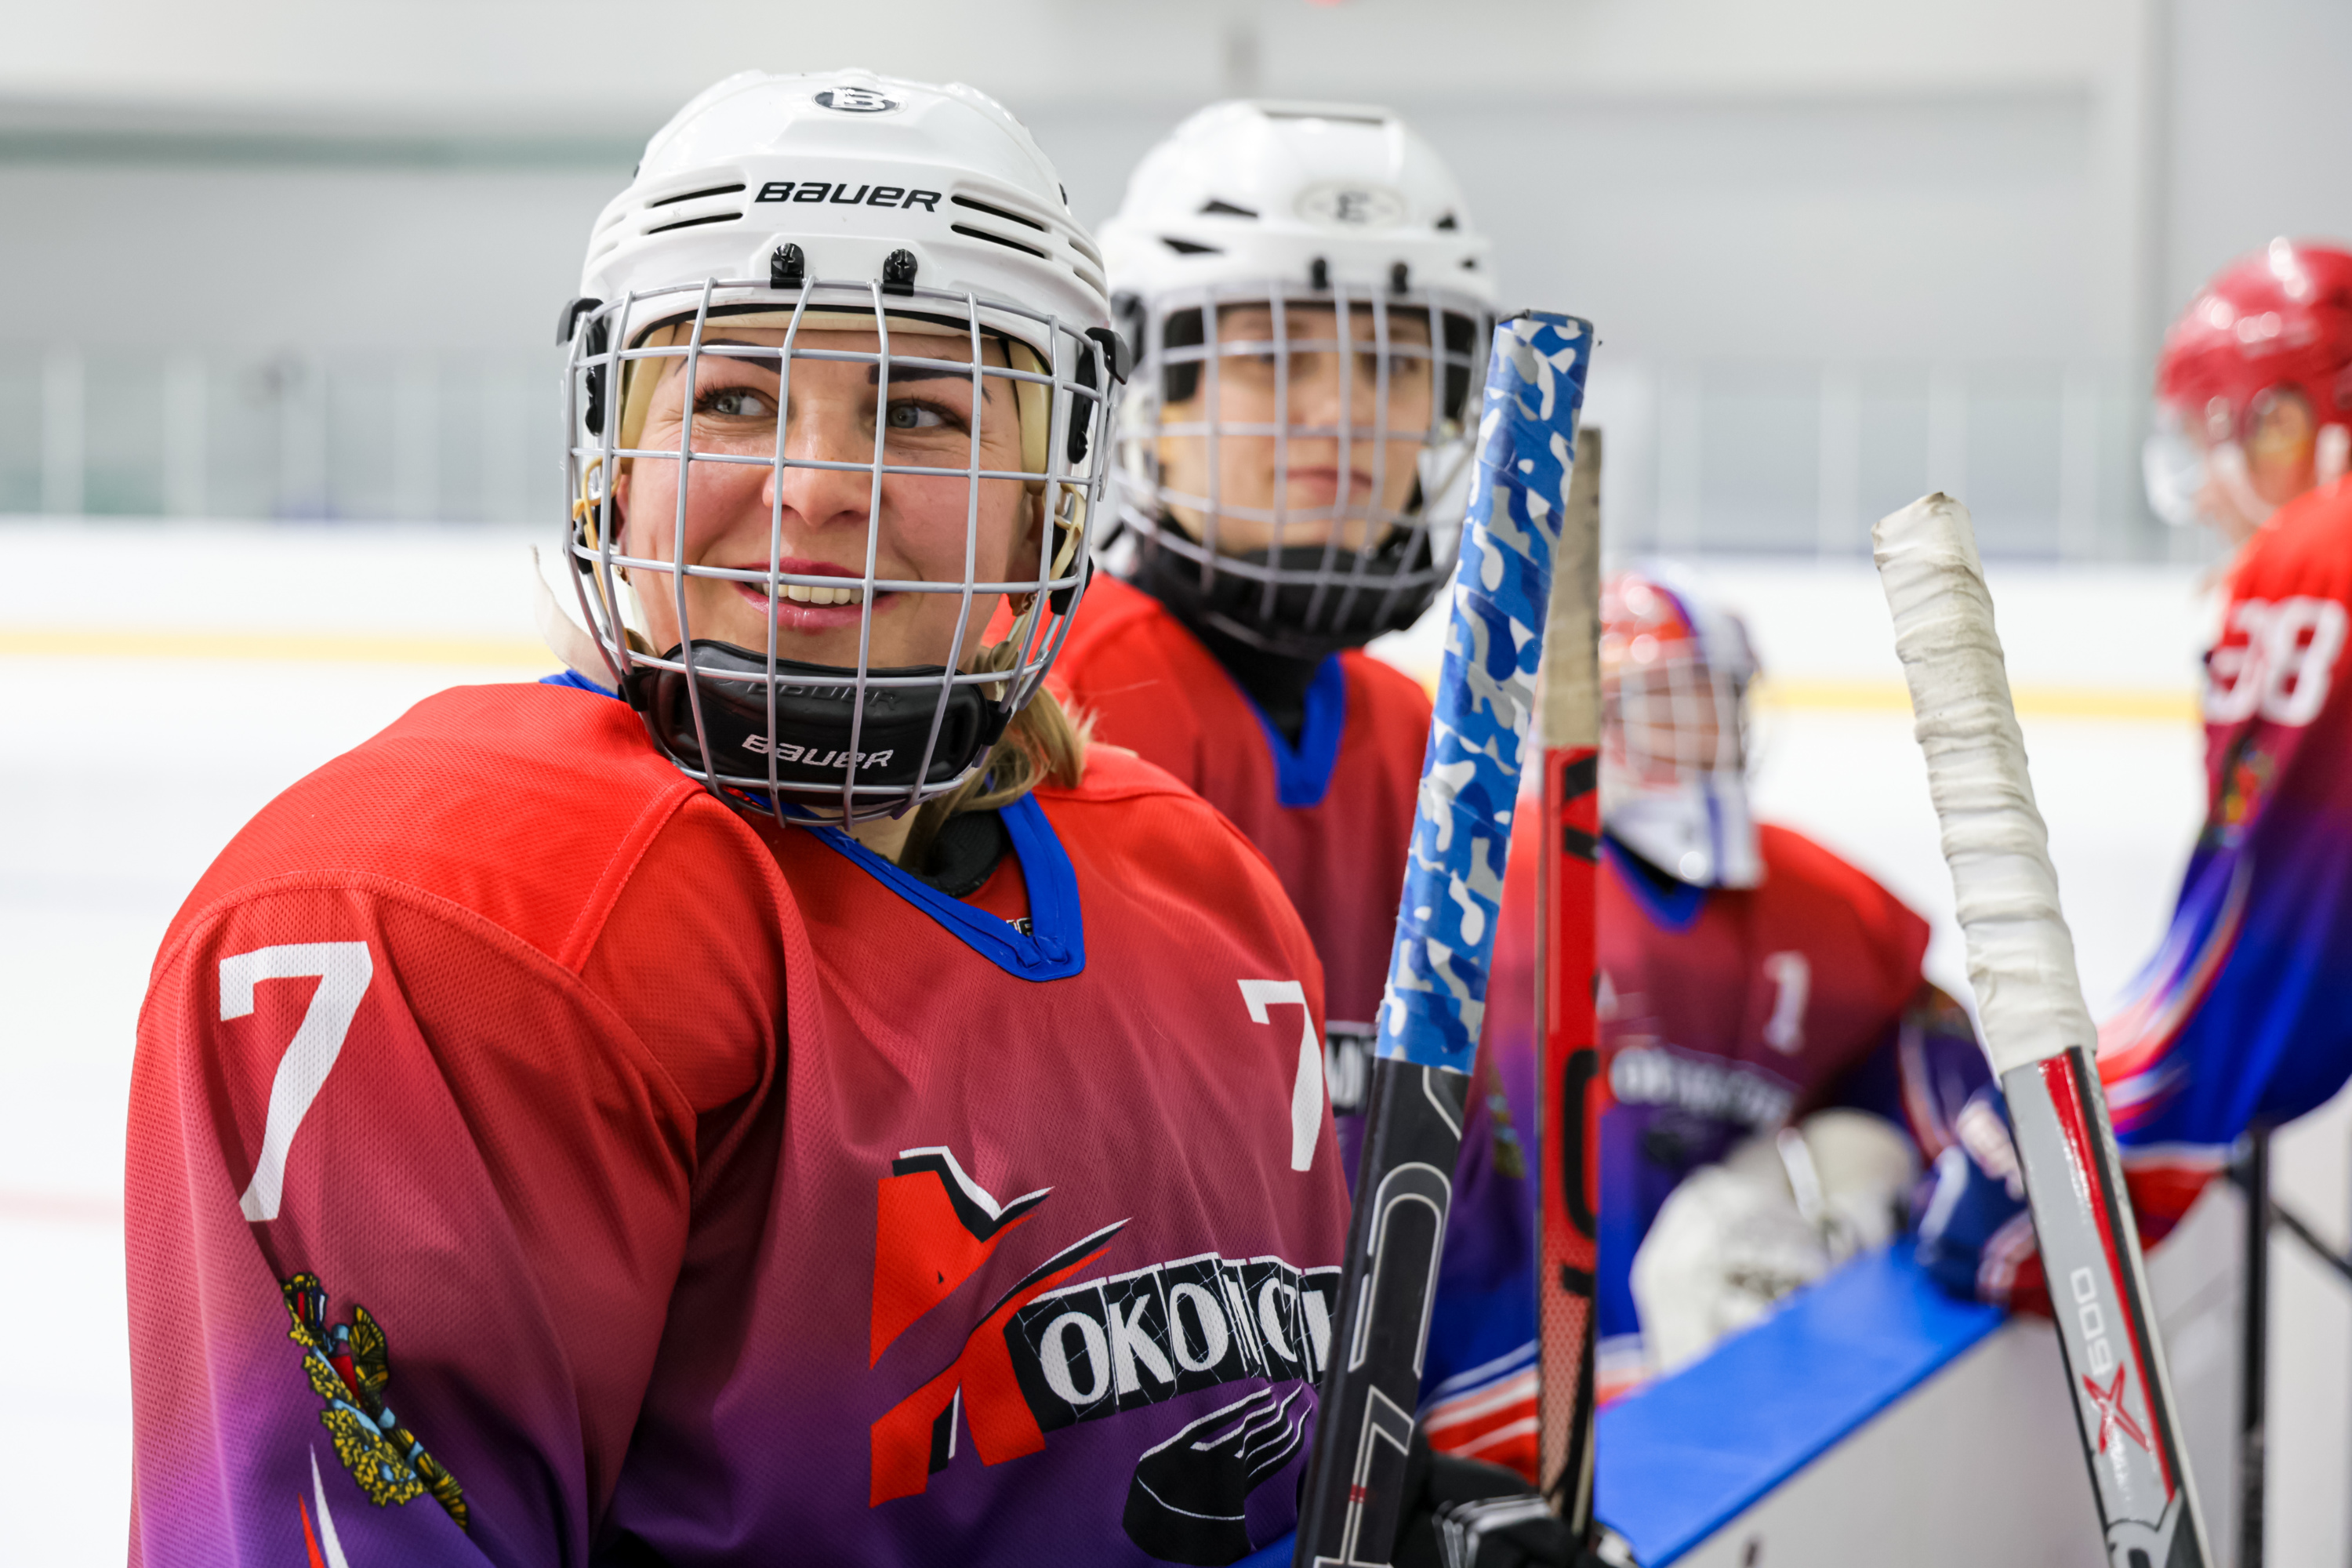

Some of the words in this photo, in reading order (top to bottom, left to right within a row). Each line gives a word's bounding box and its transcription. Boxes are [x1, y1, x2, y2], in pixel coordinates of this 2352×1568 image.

[754, 180, 942, 213] BAUER
[741, 733, 895, 770] BAUER
[1762, 949, 1811, 1054] 1
[219, 941, 374, 1222] 7
[1236, 978, 1324, 1172] 7
